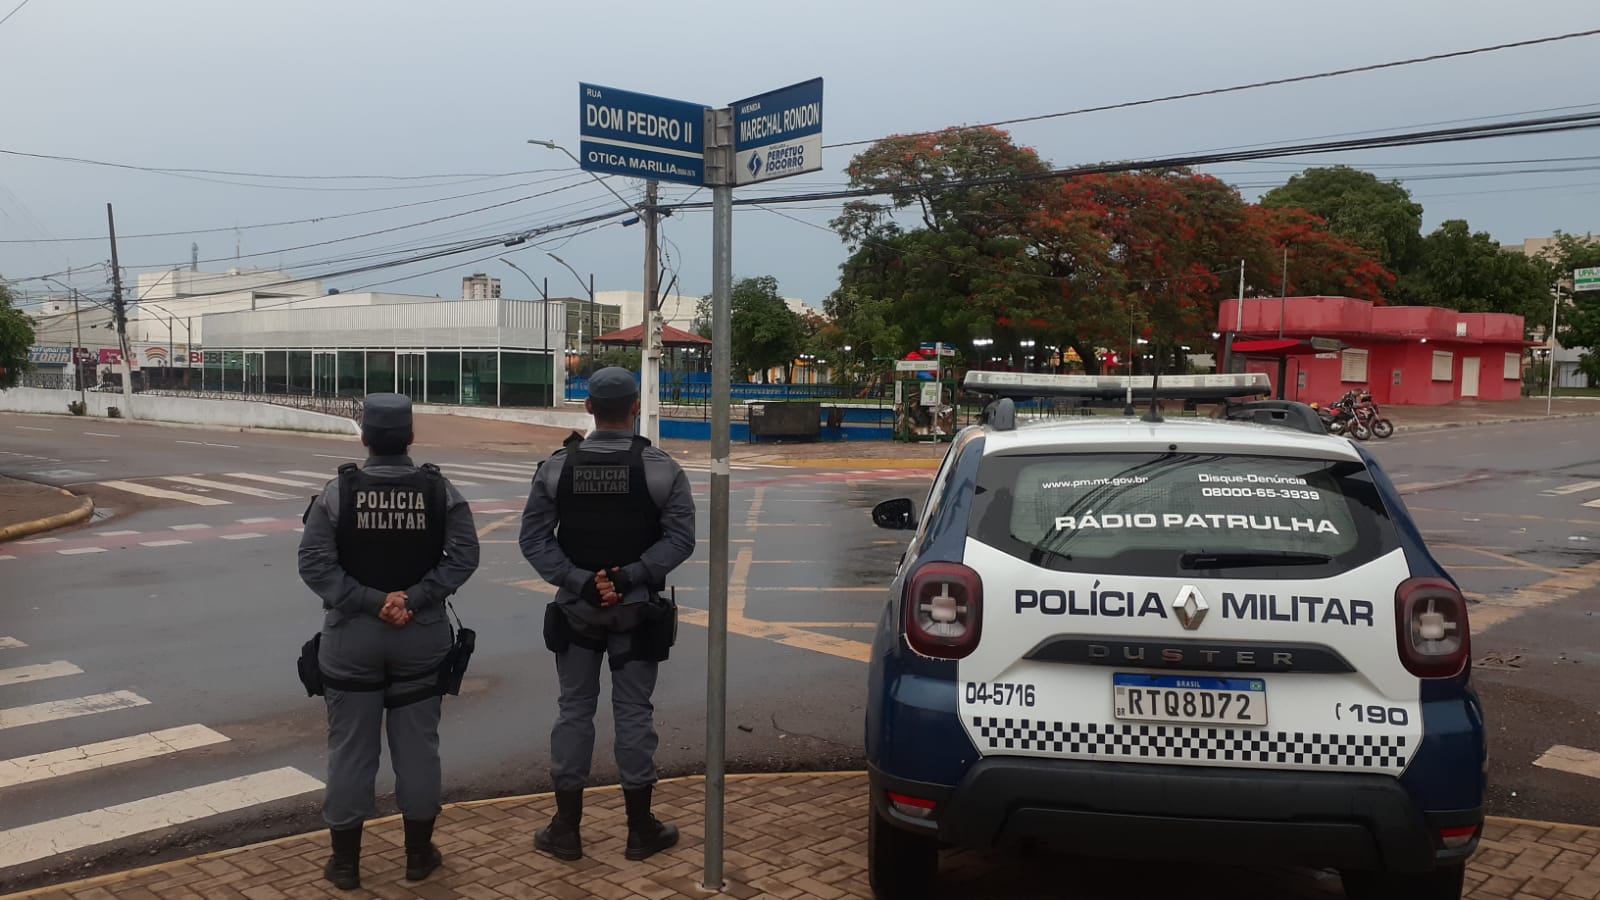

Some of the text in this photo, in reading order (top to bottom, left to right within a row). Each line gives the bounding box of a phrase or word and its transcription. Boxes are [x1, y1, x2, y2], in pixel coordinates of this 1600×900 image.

[586, 87, 602, 99] RUA
[586, 103, 693, 144] DOM PEDRO II
[740, 102, 820, 143] MARECHAL RONDON
[588, 151, 627, 167] OTICA
[629, 157, 677, 176] MARILIA
[575, 480, 628, 493] MILITAR
[1042, 475, 1150, 490] www.pm.mt.gov.br
[1198, 472, 1308, 485] Disque-Denúncia
[356, 488, 425, 510] POLÍCIA
[1201, 487, 1321, 501] 08000-65-3939
[357, 511, 426, 530] MILITAR
[1054, 510, 1340, 535] RÁDIO PATRULHA
[1014, 579, 1374, 627] POLÍCIA MILITAR
[1086, 643, 1294, 666] DUSTER
[965, 681, 1036, 708] 04-5716
[1176, 680, 1201, 688] BRASIL
[1128, 688, 1252, 720] RTQ8D72
